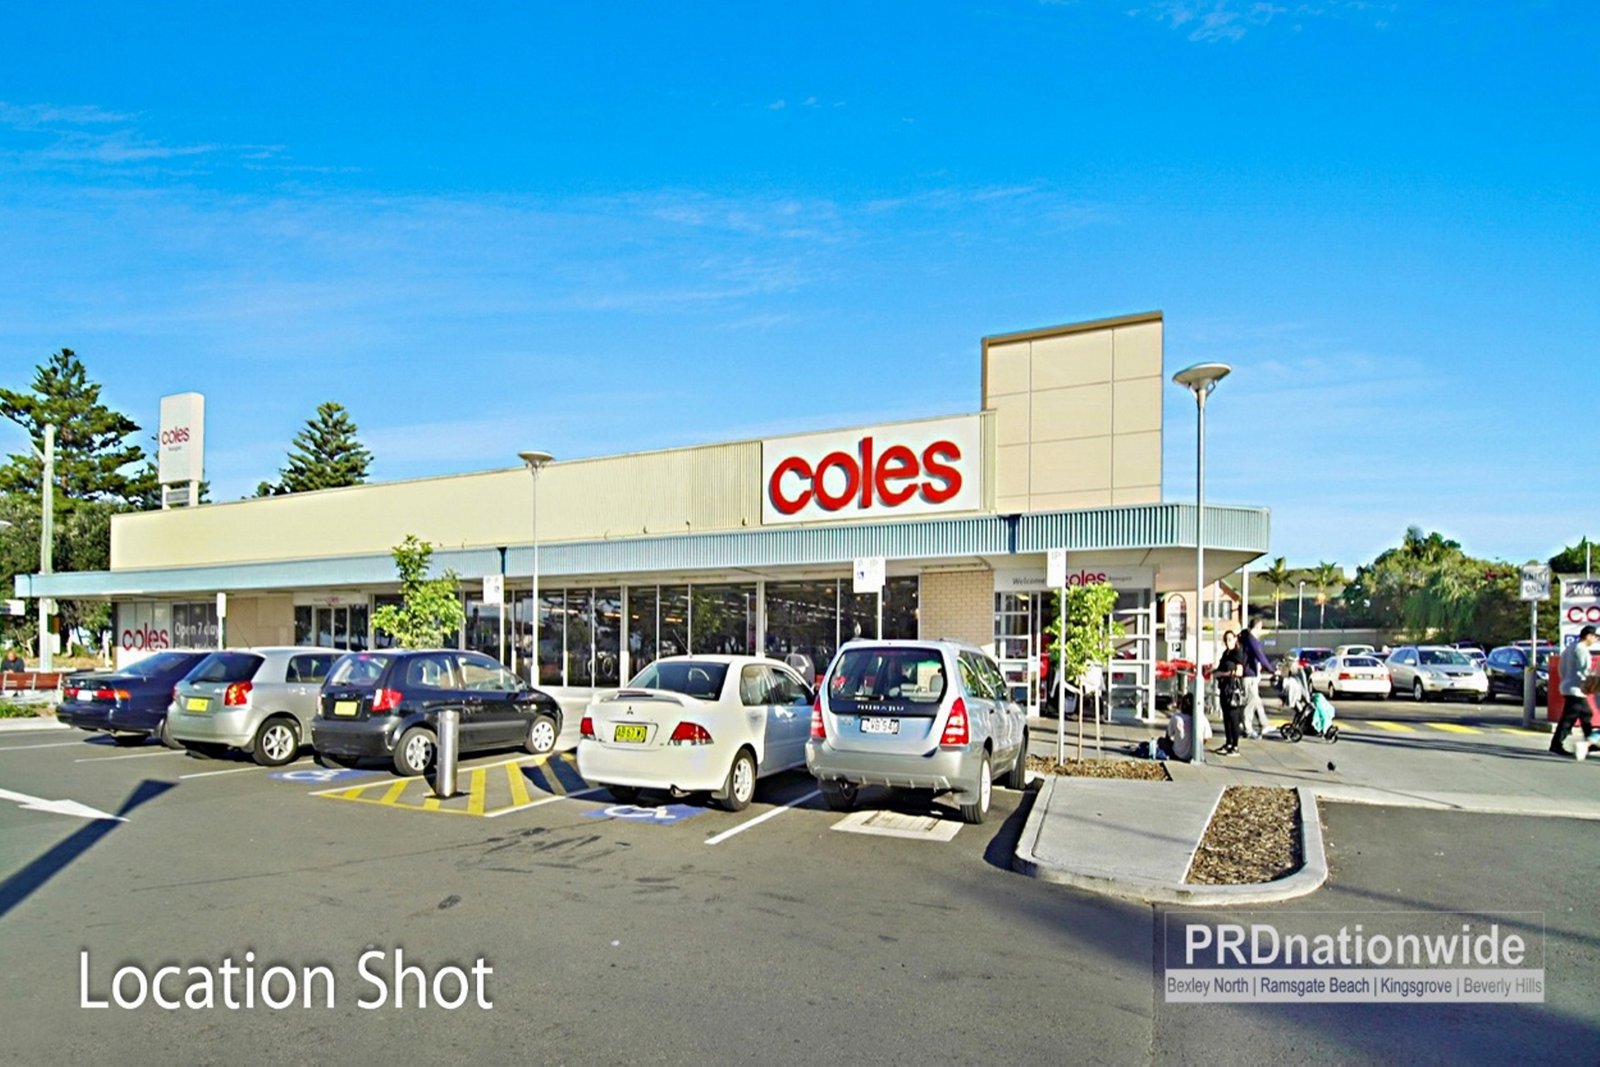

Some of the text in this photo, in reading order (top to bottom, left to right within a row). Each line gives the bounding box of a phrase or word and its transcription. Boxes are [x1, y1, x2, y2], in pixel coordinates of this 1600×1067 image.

[162, 426, 190, 445] coles
[769, 437, 962, 515] coles
[1065, 569, 1106, 589] oles
[1523, 571, 1548, 580] ENTRY
[1525, 584, 1546, 592] ONLY
[122, 622, 169, 651] coles
[175, 622, 197, 639] Open
